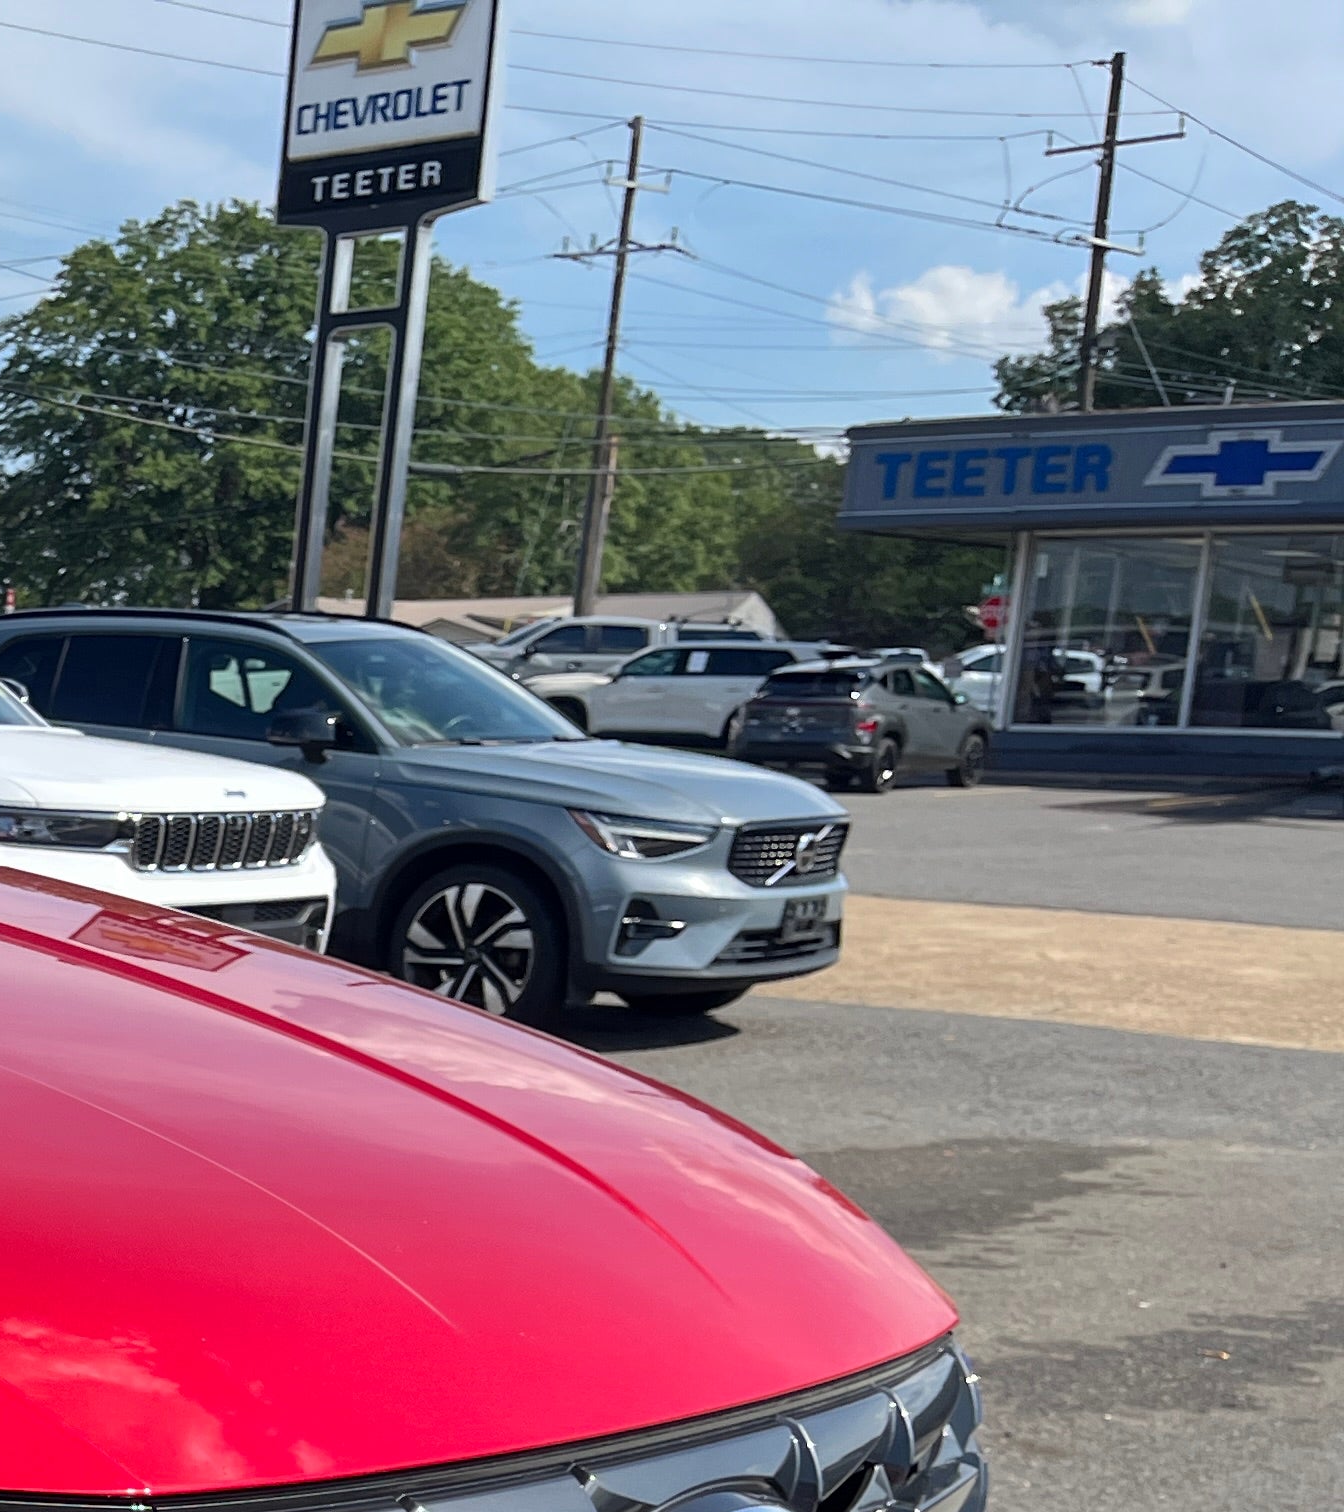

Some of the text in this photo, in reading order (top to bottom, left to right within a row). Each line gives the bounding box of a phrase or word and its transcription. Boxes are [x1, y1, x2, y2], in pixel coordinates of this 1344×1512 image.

[296, 80, 472, 136] CHEVROLET
[311, 160, 442, 202] TEETER
[876, 444, 1113, 499] TEETER
